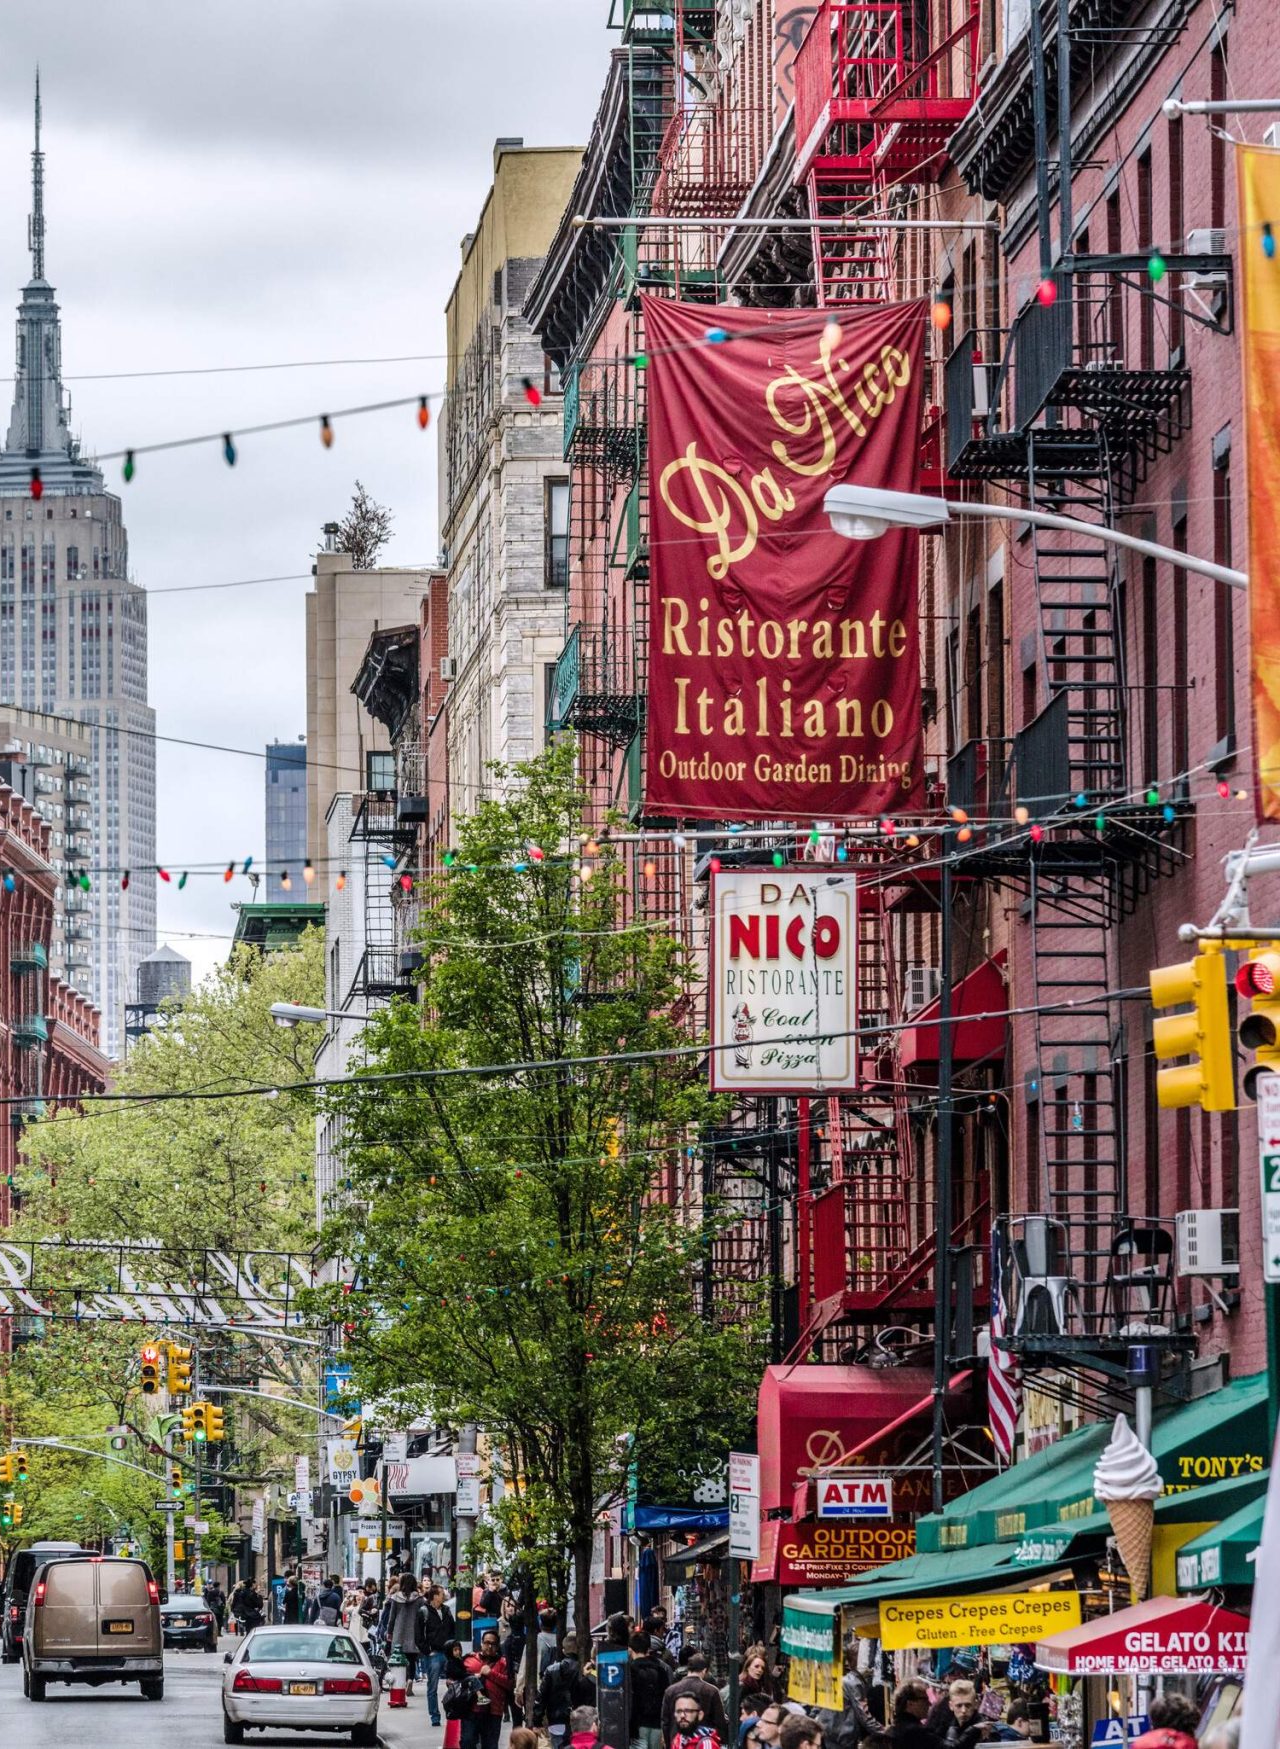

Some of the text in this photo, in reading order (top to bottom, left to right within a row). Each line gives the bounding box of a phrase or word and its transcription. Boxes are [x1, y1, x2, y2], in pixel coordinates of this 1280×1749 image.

[659, 337, 911, 581] Da Nico
[661, 596, 907, 660] Ristorante
[674, 676, 895, 740] Italiano
[659, 750, 912, 790] Outdoor Garden Dining
[761, 883, 810, 906] DA
[729, 914, 840, 961] NICO
[726, 969, 844, 995] RISTORANTE
[761, 1007, 815, 1027] Coal
[760, 1048, 817, 1069] Pizza
[333, 1471, 357, 1480] GYPSY
[1179, 1454, 1263, 1477] TONY'S
[732, 1495, 738, 1512] 2
[823, 1484, 887, 1503] ATM
[782, 1544, 875, 1559] GARDEN
[886, 1599, 1071, 1624] Crepes Crepes Crepes
[916, 1629, 957, 1641] Gluten
[969, 1625, 996, 1638] Free
[999, 1623, 1043, 1638] Crepes
[1125, 1632, 1210, 1652] GELATO
[1075, 1656, 1114, 1669] HOME
[1118, 1656, 1157, 1669] MADE
[1161, 1656, 1214, 1669] GELATO
[1218, 1656, 1228, 1669] &
[608, 1666, 619, 1683] P
